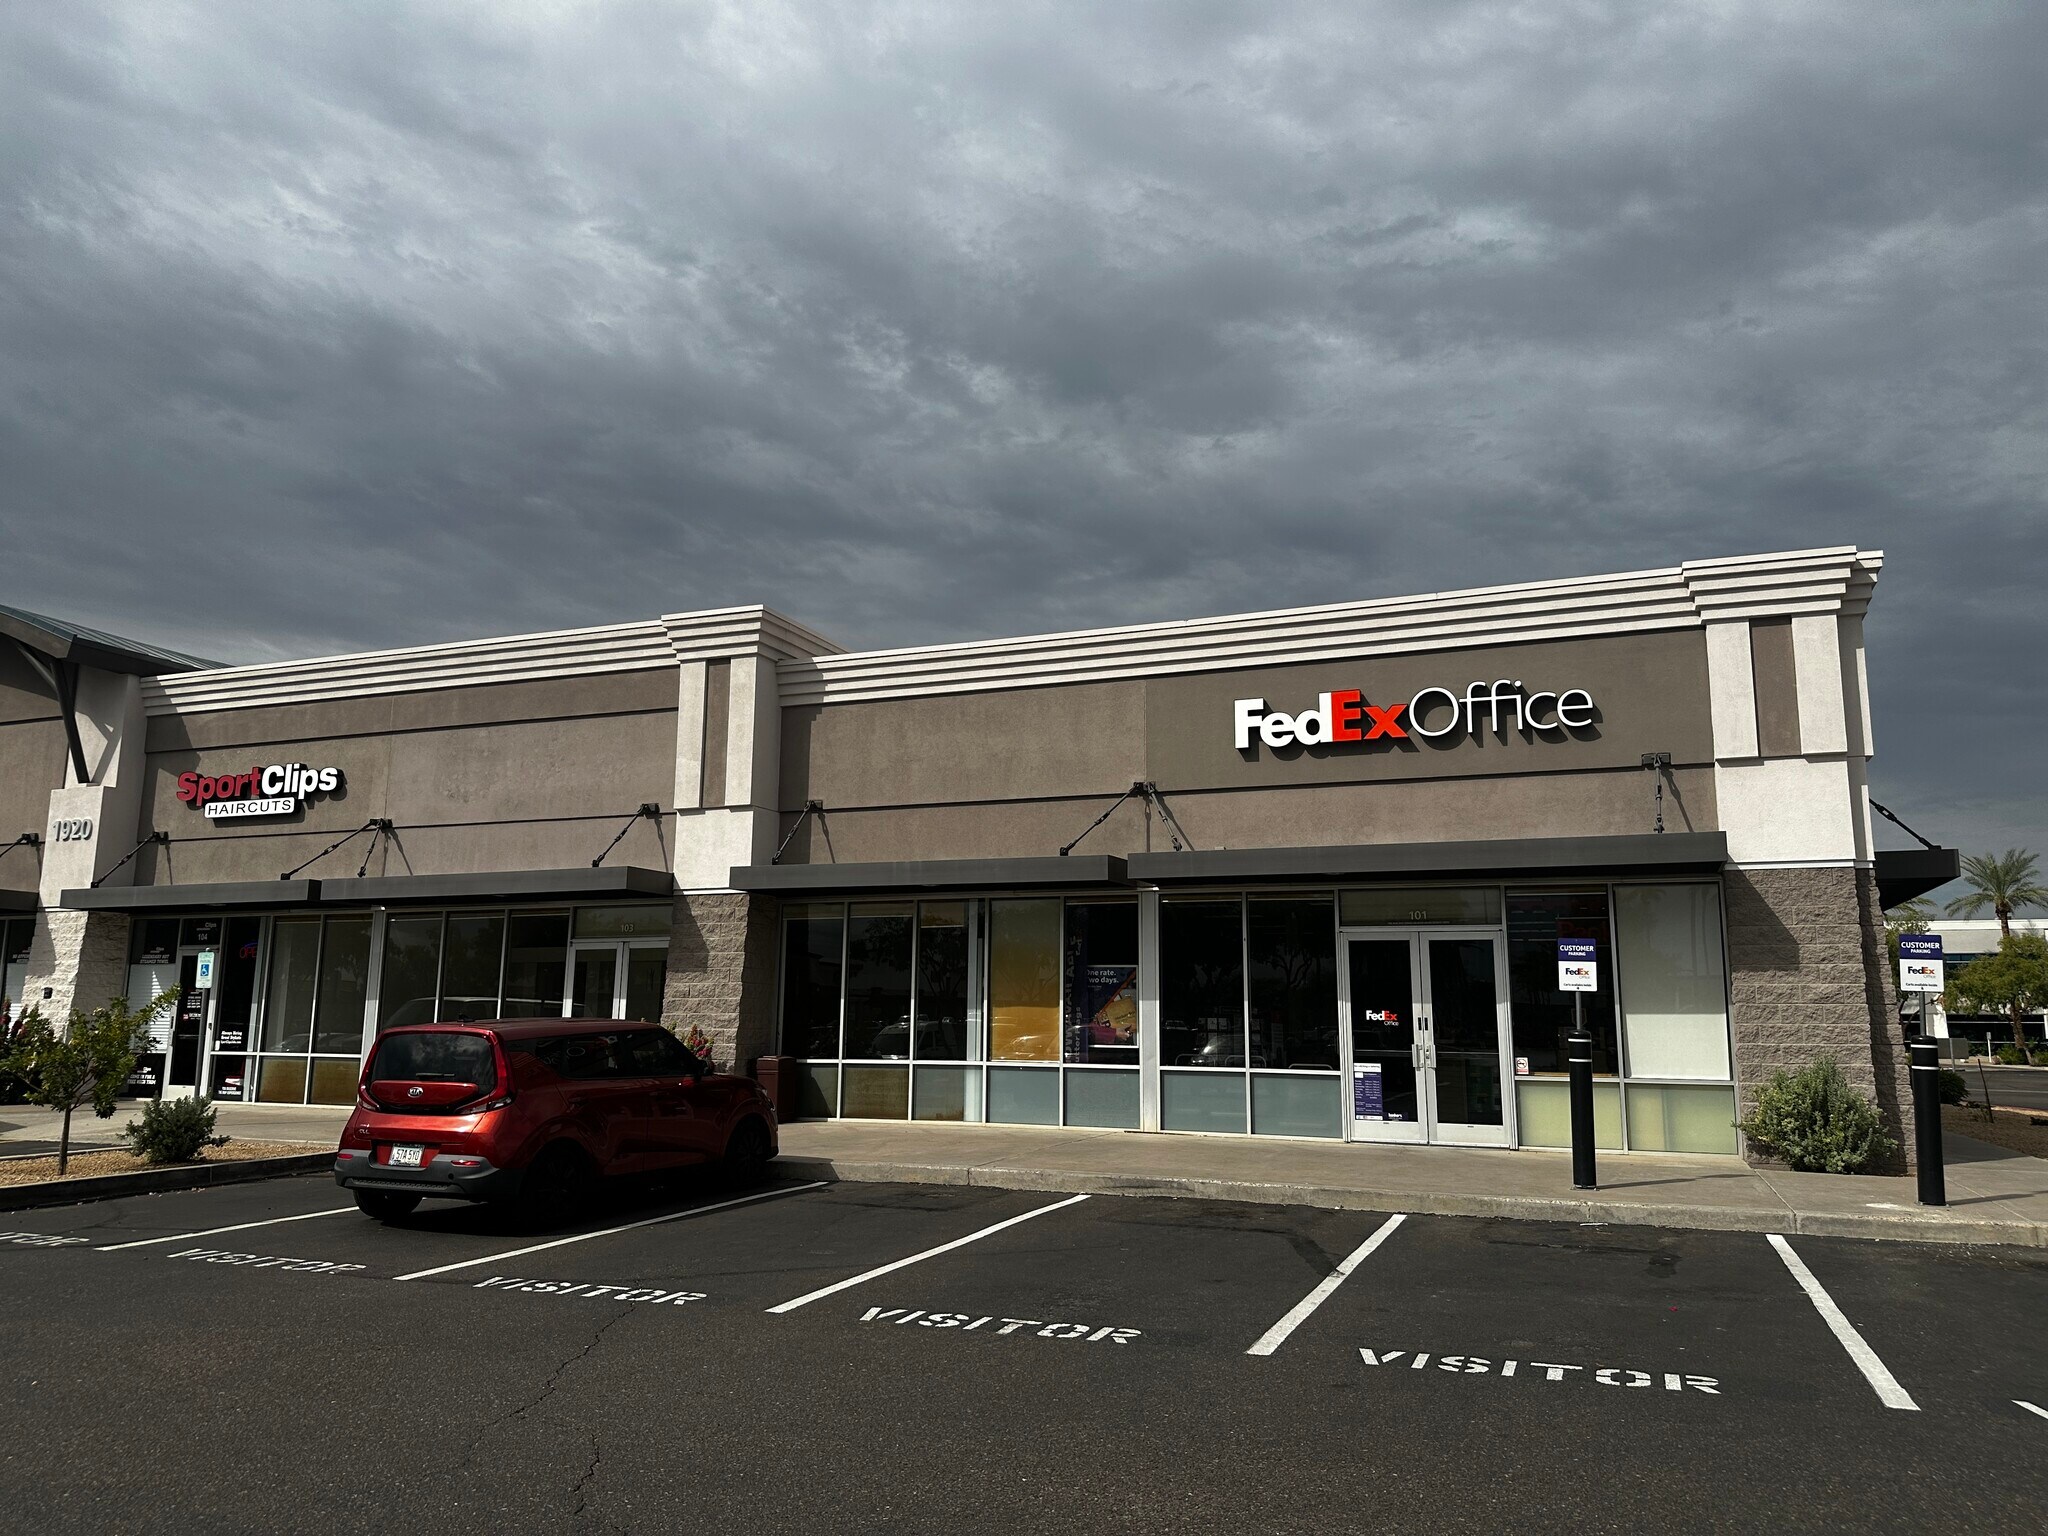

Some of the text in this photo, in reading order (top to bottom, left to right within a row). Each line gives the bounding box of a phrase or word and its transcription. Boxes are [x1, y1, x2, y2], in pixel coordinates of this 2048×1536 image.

[1233, 679, 1594, 749] FedEx Office
[208, 800, 292, 815] HAIRCUTS
[52, 818, 93, 841] 1920
[1409, 910, 1427, 920] 101
[621, 923, 634, 933] 103
[1559, 944, 1594, 952] CUSTOMER
[1901, 941, 1940, 949] CUSTOMER
[1565, 968, 1589, 976] FedEx
[1908, 966, 1935, 974] FedEx
[1100, 976, 1120, 985] days.
[1365, 1010, 1398, 1020] FedEx
[166, 1248, 367, 1275] VISITOR
[472, 1276, 707, 1305] VISITOR
[859, 1306, 1142, 1344] VISITOR
[1358, 1347, 1722, 1395] VISITOR
